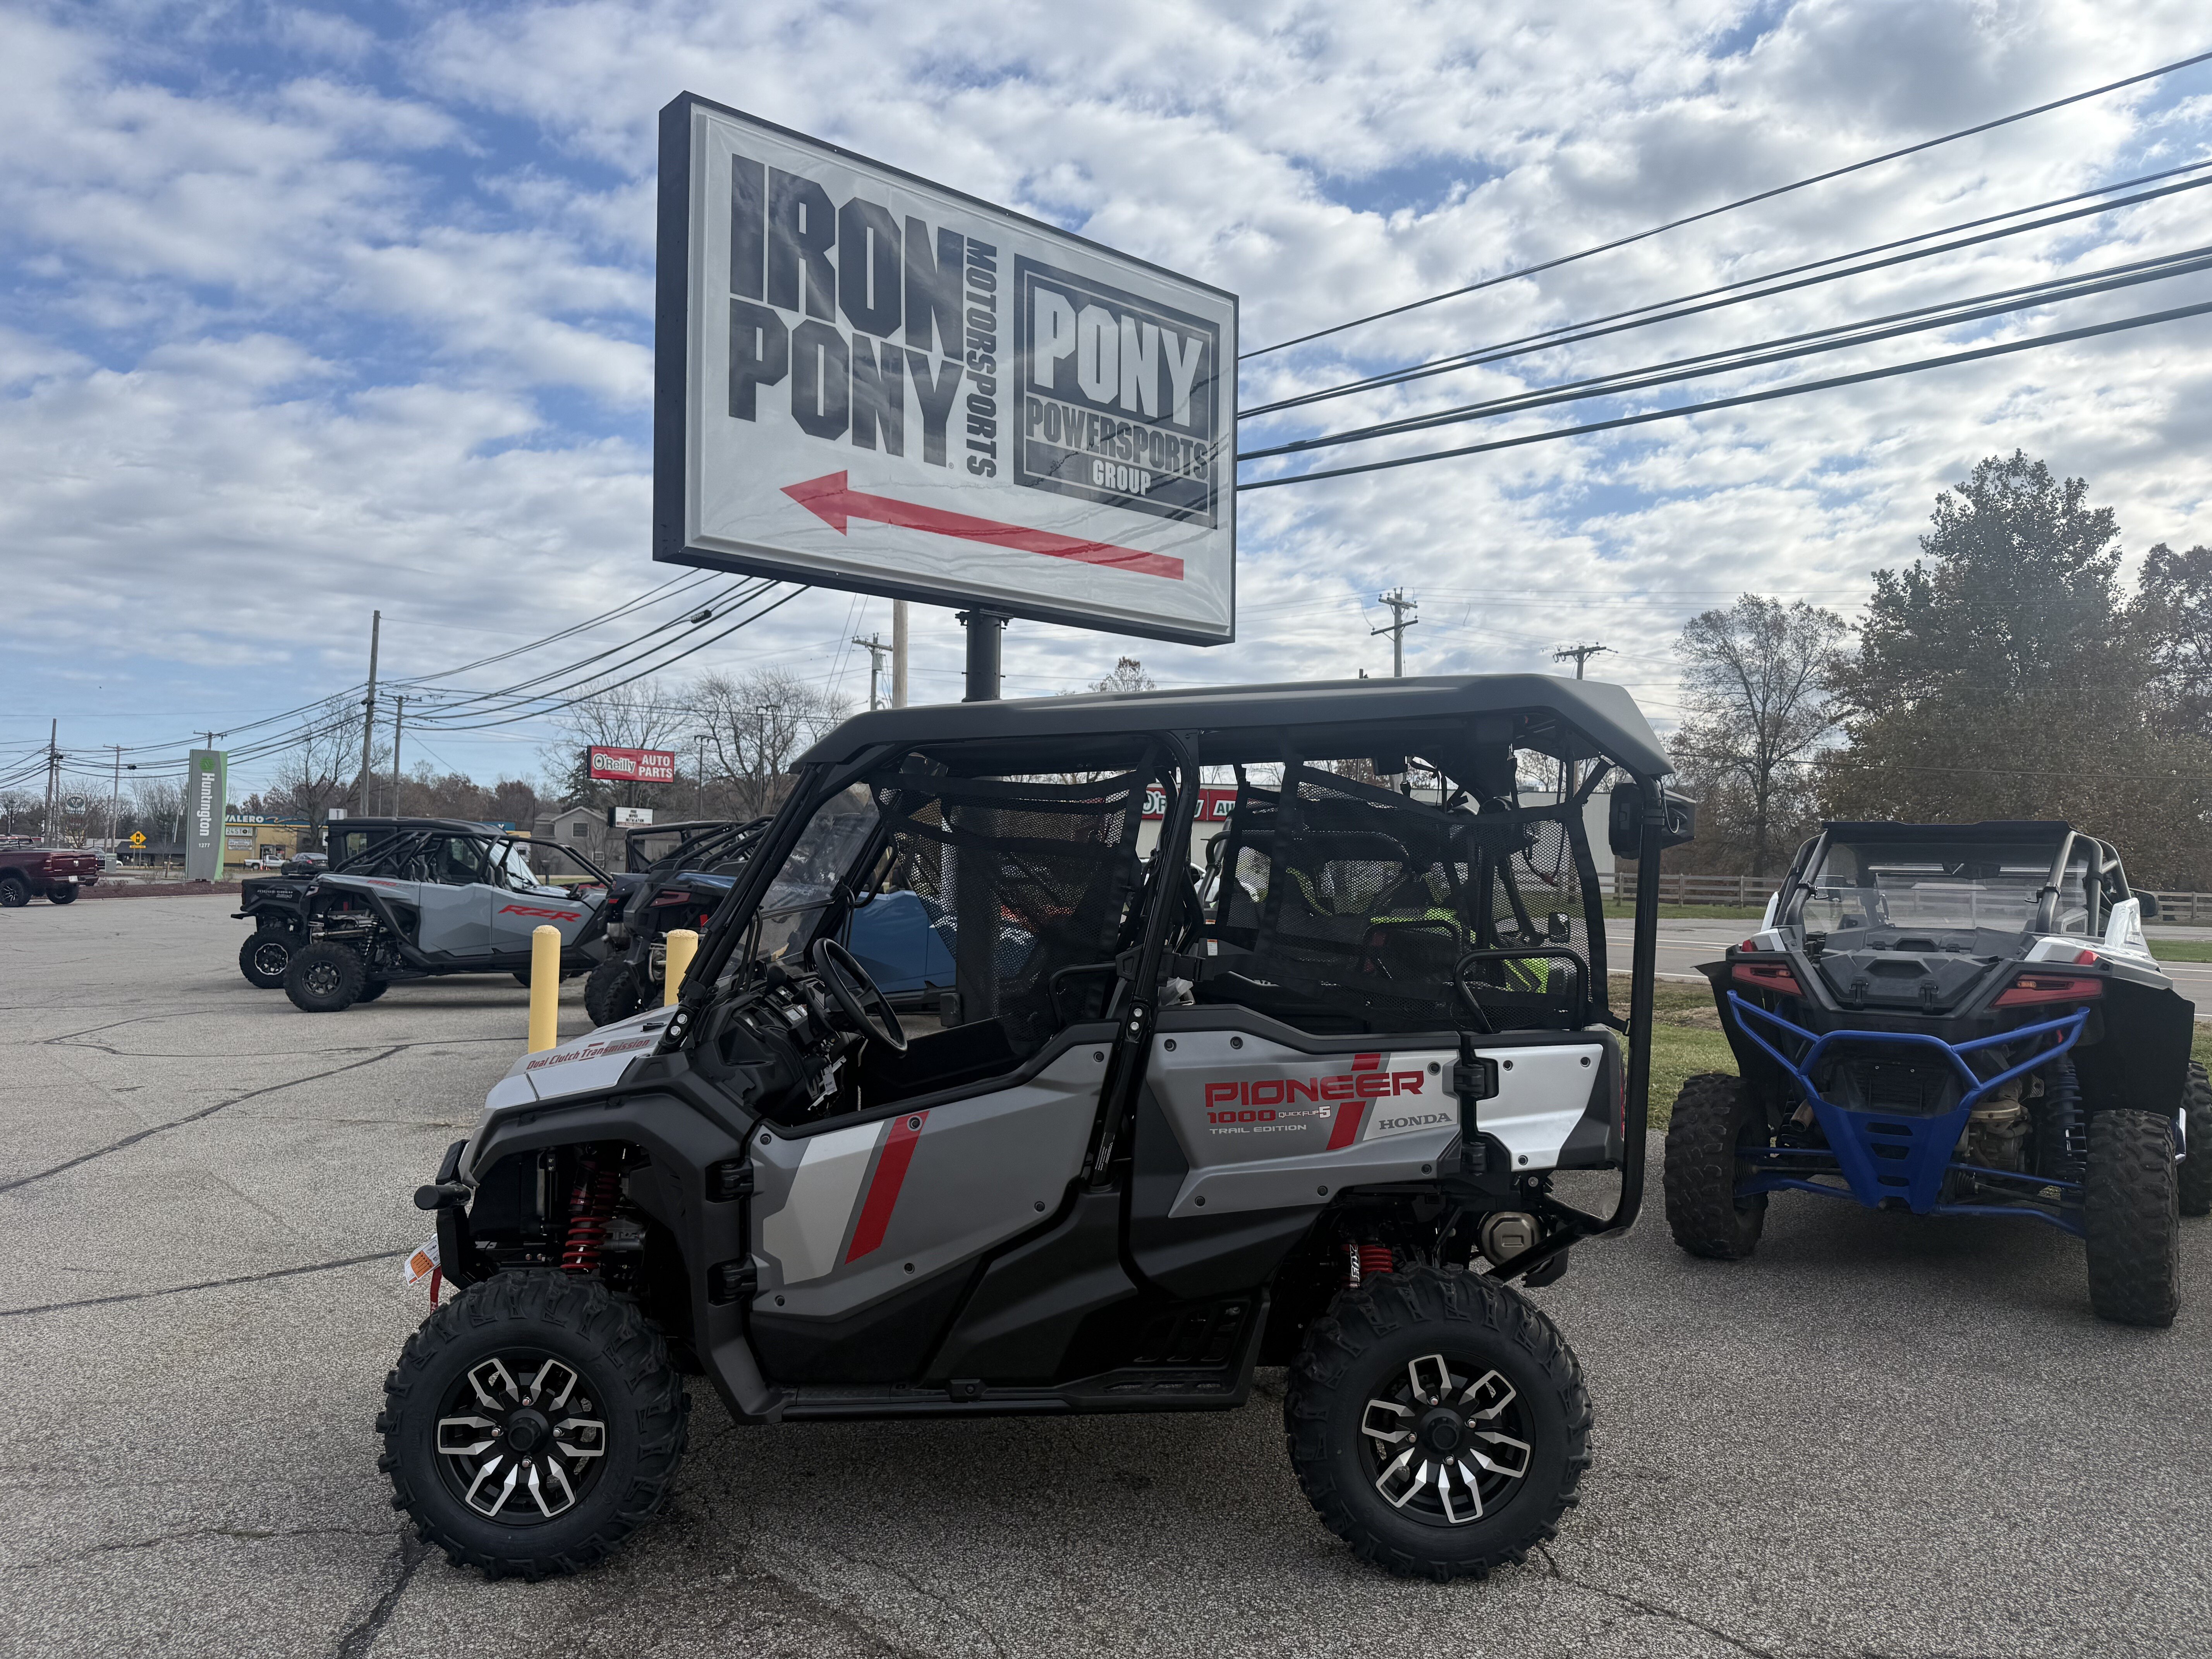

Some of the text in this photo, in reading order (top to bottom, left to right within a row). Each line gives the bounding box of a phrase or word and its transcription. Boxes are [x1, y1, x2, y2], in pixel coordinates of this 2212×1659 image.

[730, 153, 964, 362] IRON
[966, 237, 997, 478] MOTORSPORTS
[1034, 287, 1204, 426] PONY
[728, 297, 964, 468] PONY
[1026, 395, 1207, 480] POWERSPORTS
[1093, 459, 1151, 495] GROUP
[593, 753, 635, 773] O'Reilly
[639, 766, 673, 778] PARTS
[642, 755, 670, 766] AUTO
[197, 773, 215, 836] Huntington
[225, 815, 264, 823] VALERO
[498, 905, 582, 922] RZR
[526, 1039, 651, 1070] Dual Clutch Transmission
[1205, 1070, 1424, 1108] PIONEER
[1207, 1109, 1276, 1124] 1000
[1253, 1125, 1307, 1133] EDITION
[1379, 1113, 1453, 1130] HONDA
